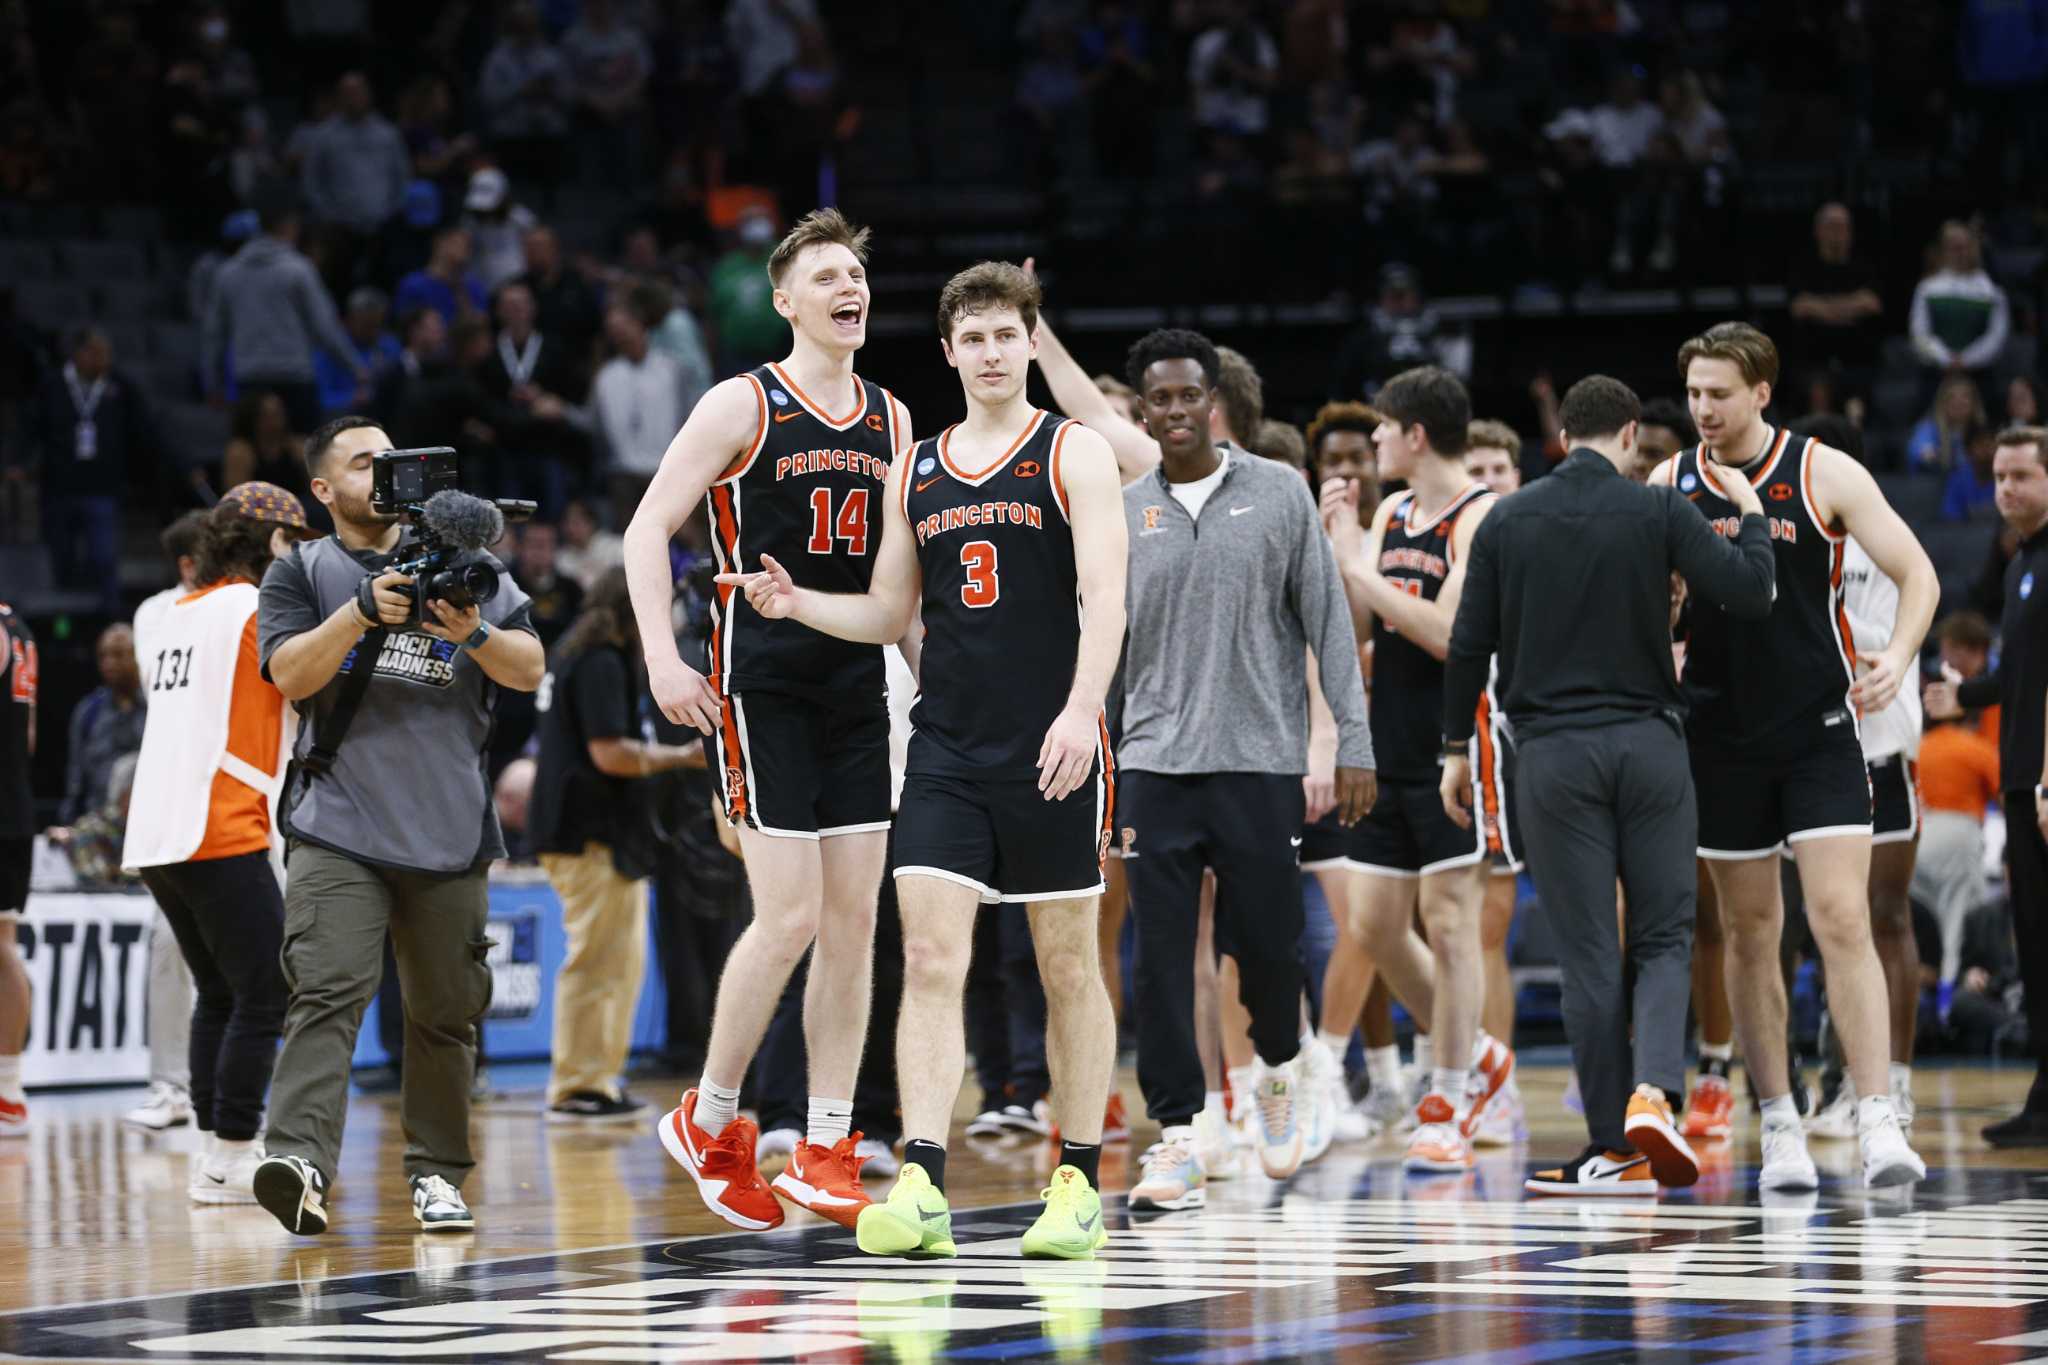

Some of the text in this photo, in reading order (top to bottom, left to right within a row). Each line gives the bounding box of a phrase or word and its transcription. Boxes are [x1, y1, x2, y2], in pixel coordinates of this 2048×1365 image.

[808, 487, 868, 555] 14
[916, 502, 1043, 547] PRINCETON
[960, 540, 999, 608] 3
[383, 632, 432, 657] ARCH
[153, 646, 193, 691] 131
